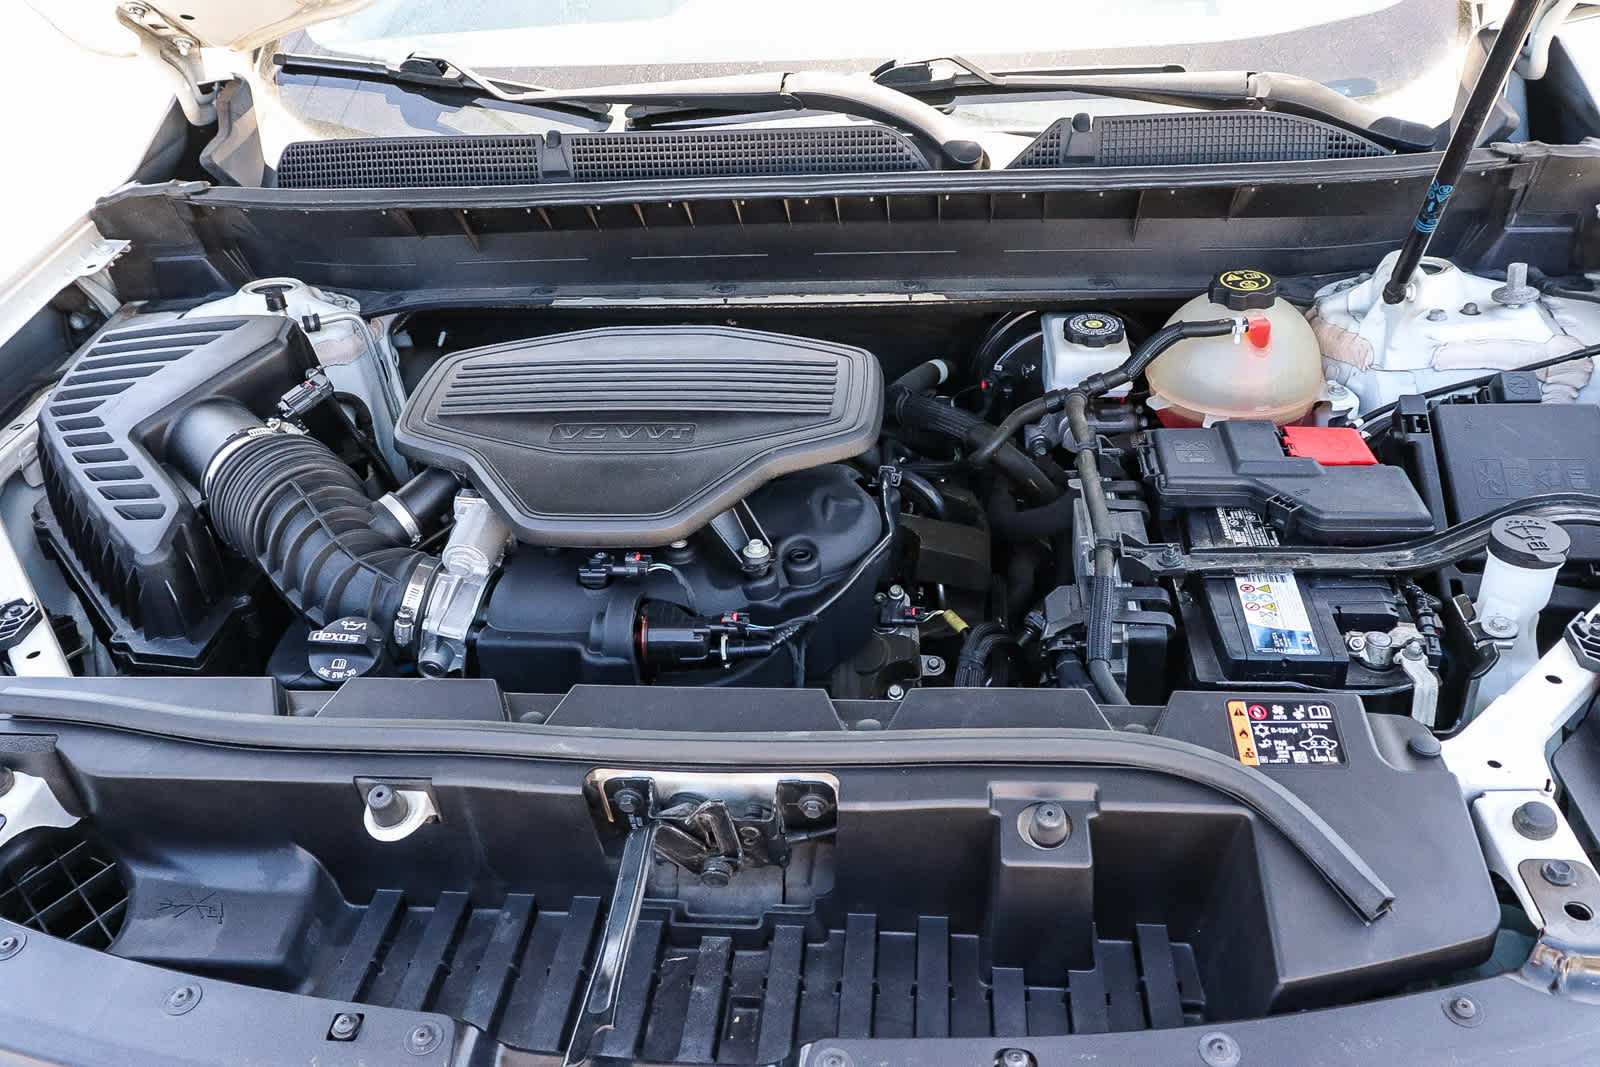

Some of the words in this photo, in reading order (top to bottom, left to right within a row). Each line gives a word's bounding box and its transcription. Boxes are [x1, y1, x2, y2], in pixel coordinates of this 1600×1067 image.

[615, 426, 691, 439] VVT
[312, 631, 360, 642] dexos
[331, 668, 356, 679] 5W-30
